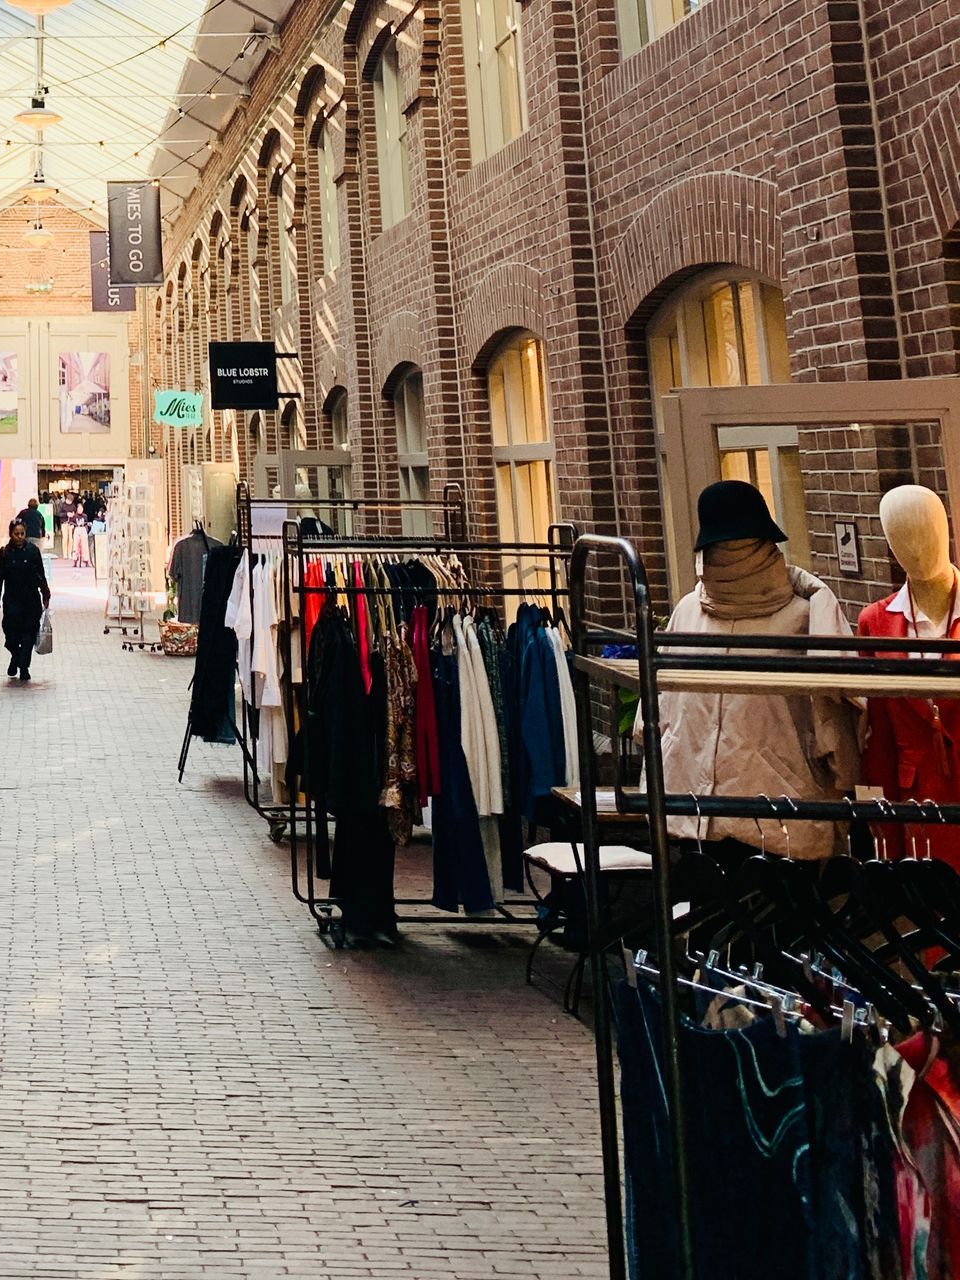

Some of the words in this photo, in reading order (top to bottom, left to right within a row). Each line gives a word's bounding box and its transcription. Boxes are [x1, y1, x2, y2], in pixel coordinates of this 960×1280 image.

[127, 187, 142, 221] MIES
[128, 224, 142, 245] TO
[128, 249, 143, 273] GO
[216, 367, 238, 377] BLUE
[238, 367, 269, 377] LOBSTR
[159, 397, 196, 419] Mies
